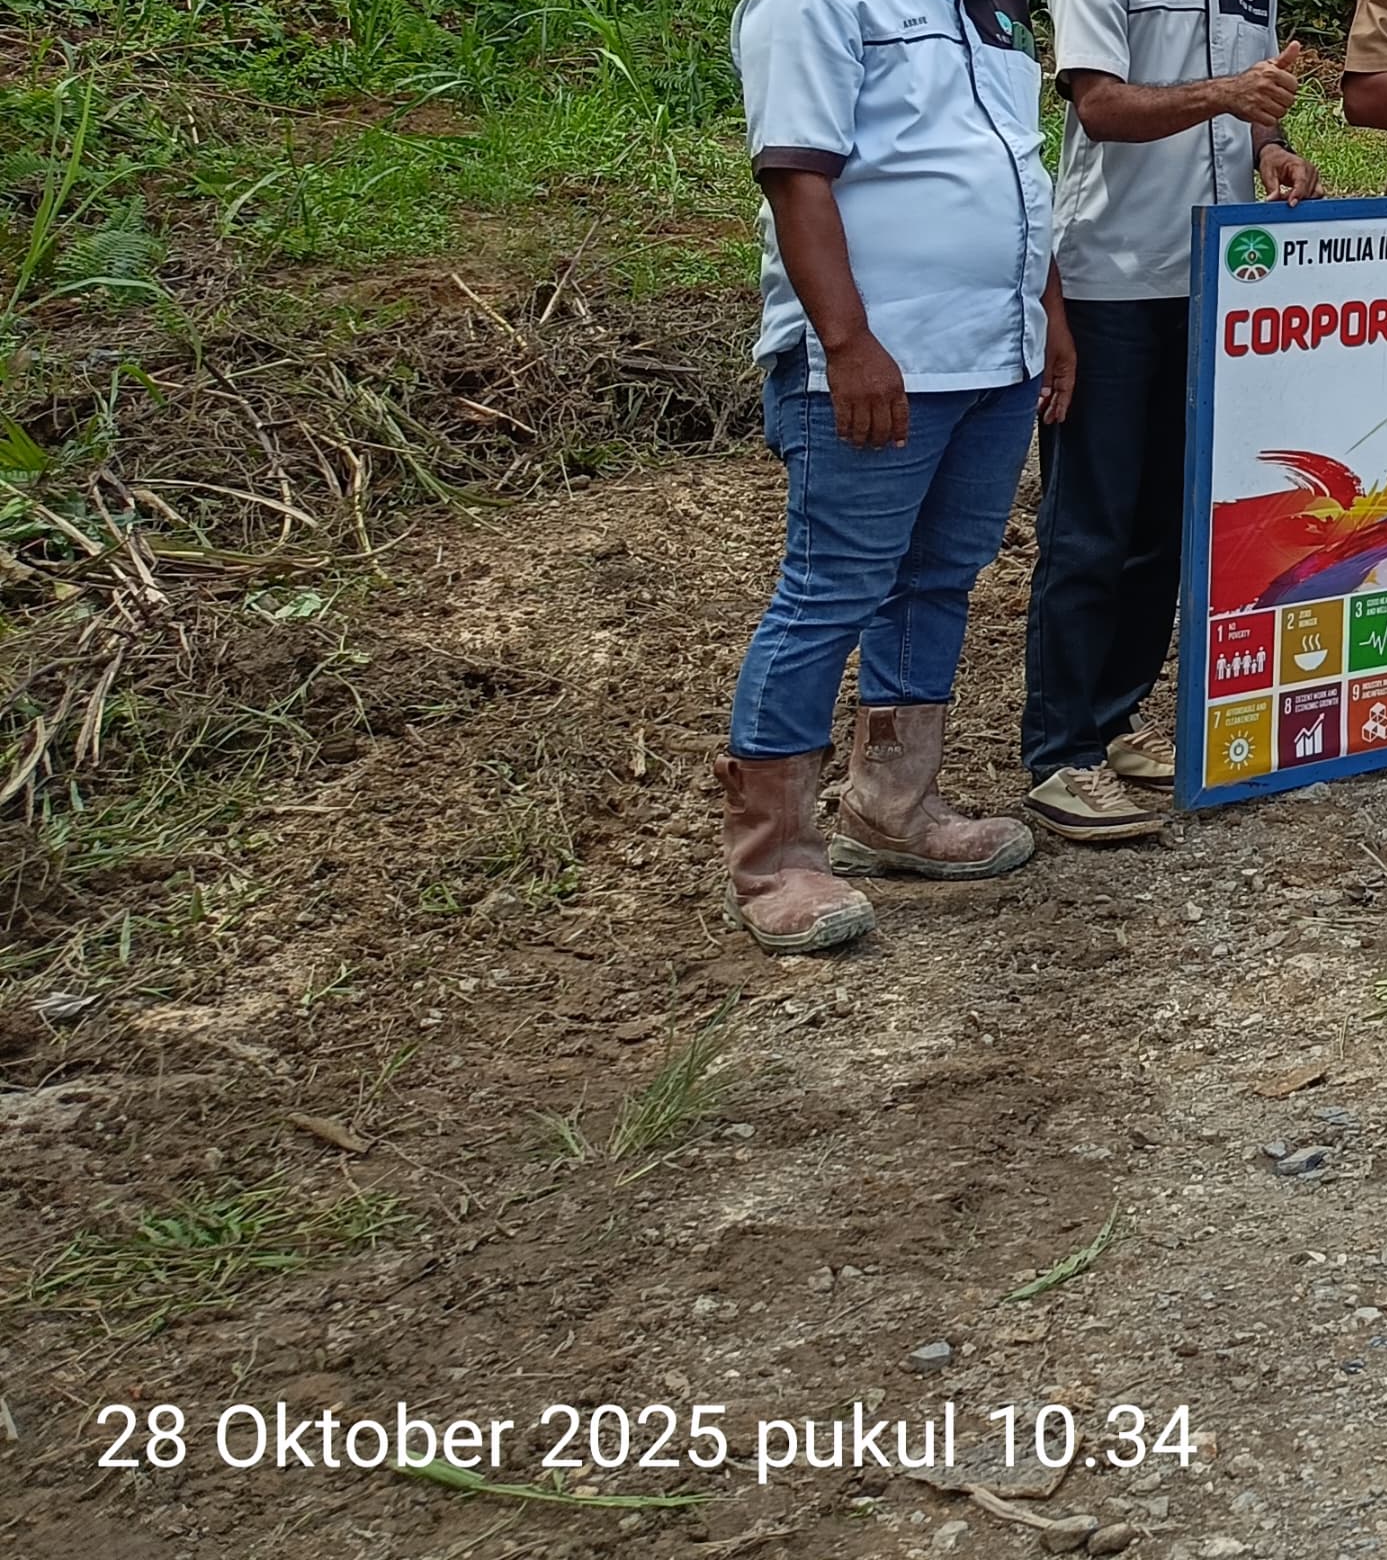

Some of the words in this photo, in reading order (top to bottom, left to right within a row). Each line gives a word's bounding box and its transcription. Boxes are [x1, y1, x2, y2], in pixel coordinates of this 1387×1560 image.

[1283, 240, 1313, 266] PT.
[1318, 237, 1373, 264] MULIA
[1355, 601, 1362, 618] 3
[1287, 613, 1294, 630] 2
[1217, 624, 1223, 643] 1
[1352, 684, 1360, 702] 9
[1284, 697, 1292, 715] 8
[1214, 711, 1221, 729] 7
